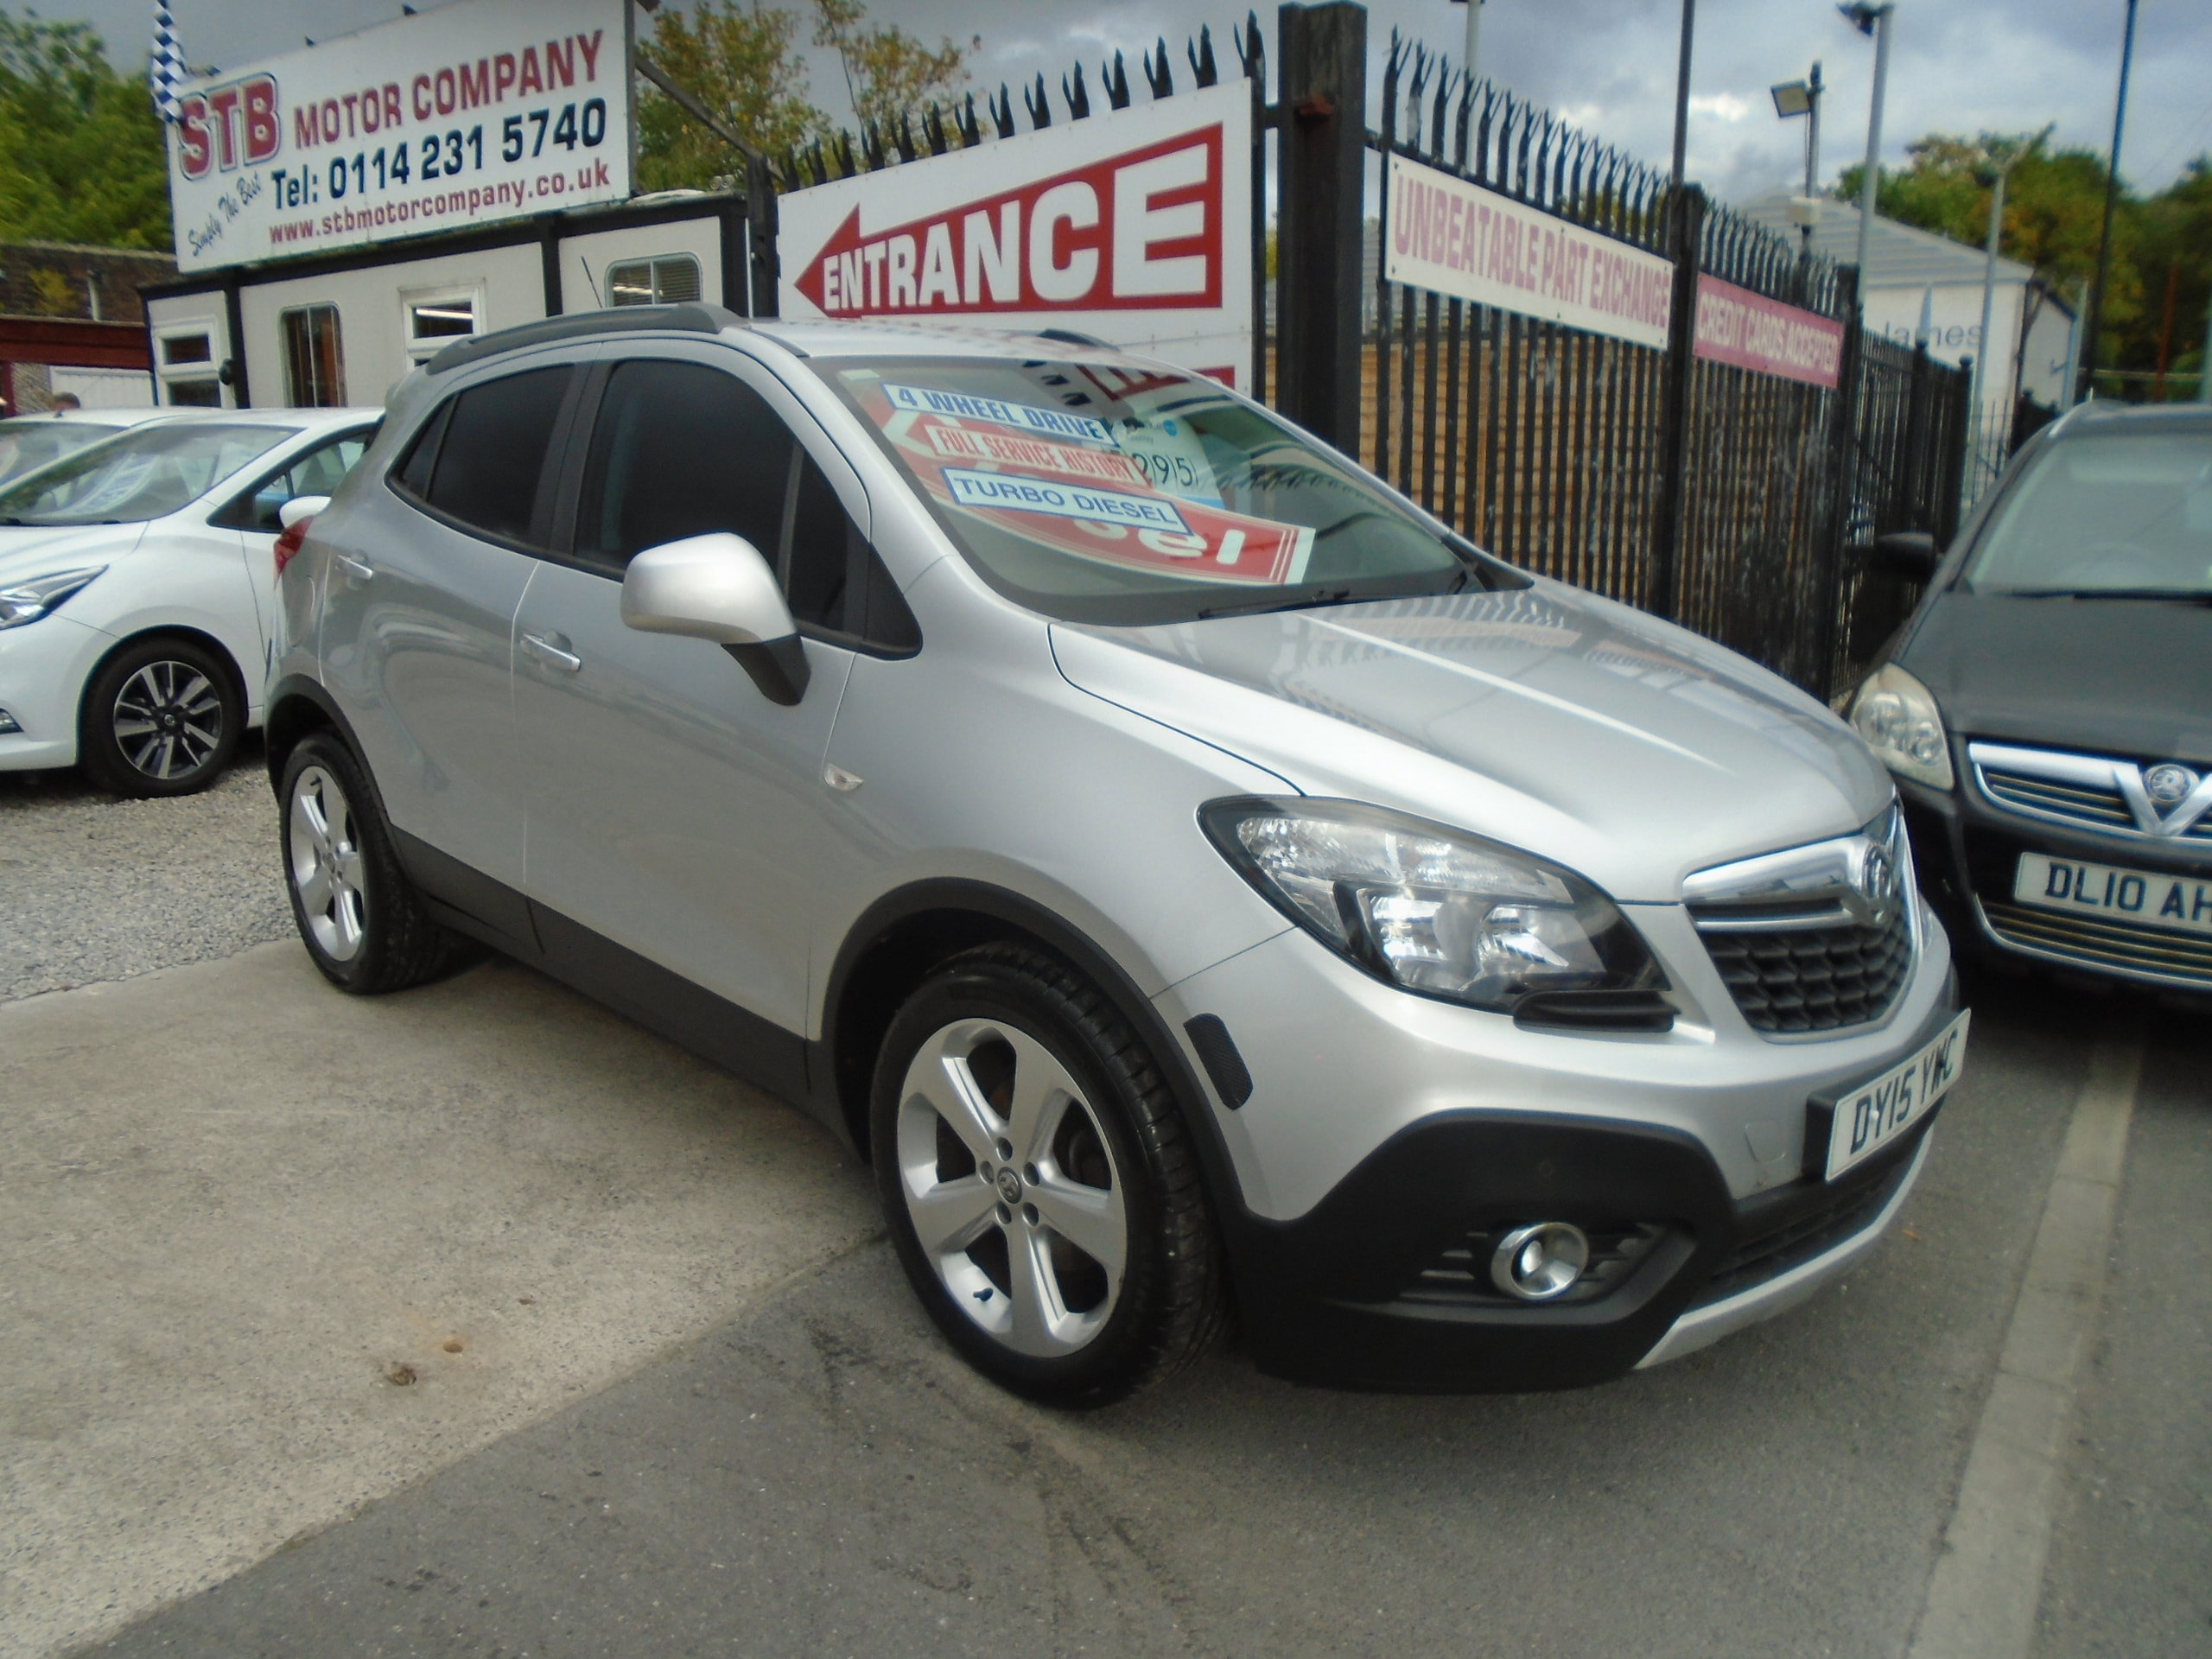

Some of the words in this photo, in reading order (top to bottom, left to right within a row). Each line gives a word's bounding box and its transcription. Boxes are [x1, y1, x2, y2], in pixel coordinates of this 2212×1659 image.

[178, 73, 281, 180] STB
[295, 83, 403, 150] MOTOR
[412, 29, 604, 122] COMPANY
[271, 169, 319, 210] Tel:
[328, 143, 410, 200] 0114
[421, 124, 483, 180] 231
[502, 98, 607, 163] 5740
[188, 212, 223, 257] Simply
[218, 192, 239, 222] The
[236, 171, 262, 206] Best
[269, 157, 610, 245] www.stbmotorcompany.co.uk
[823, 143, 1209, 310] ENTRANCE
[1394, 175, 1541, 292] UNBEATABLE
[1541, 230, 1589, 306] PART
[1590, 248, 1671, 328] EXCHANGE
[1698, 291, 1746, 349] CREDIT
[1745, 307, 1787, 360] CARDS
[1785, 321, 1839, 373] ACCEPTED
[899, 388, 918, 407] 4
[920, 391, 1021, 424] WHEEL
[1022, 407, 1105, 441] DRIVE
[935, 429, 985, 456] FULL
[982, 435, 1062, 468] SERVICE
[1058, 448, 1135, 482] HISTORY
[954, 478, 1066, 507] TURBO
[1073, 494, 1178, 525] DIESEL
[2044, 861, 2146, 912] DL10
[1850, 1065, 1916, 1155] DY15
